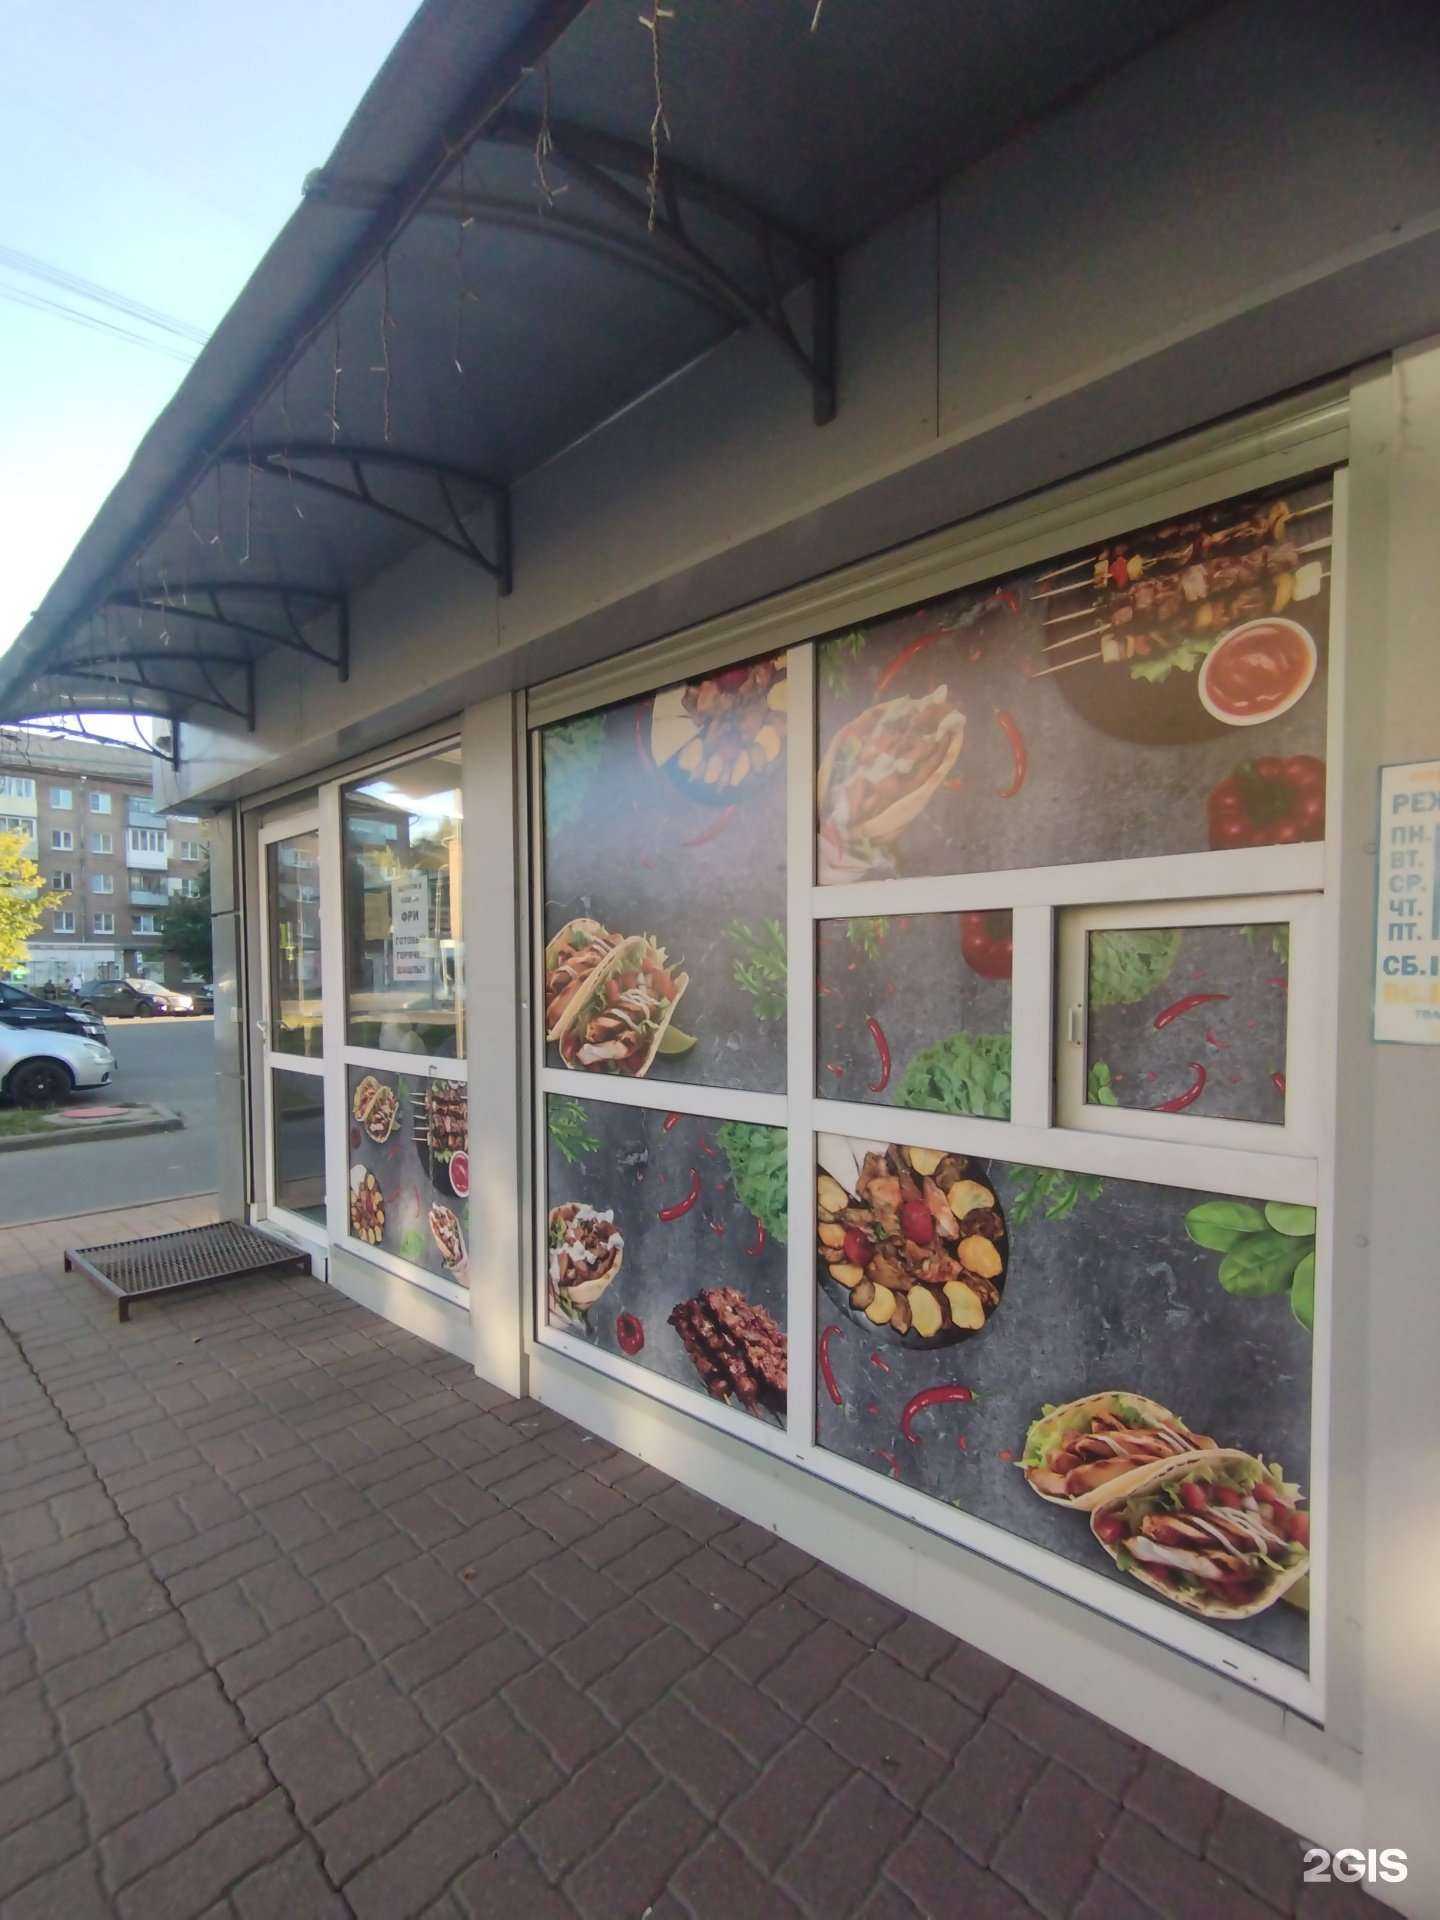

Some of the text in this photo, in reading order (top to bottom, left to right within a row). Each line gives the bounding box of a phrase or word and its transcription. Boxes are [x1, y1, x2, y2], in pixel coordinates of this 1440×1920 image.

[1389, 874, 1427, 893] СР.
[1389, 898, 1423, 917] ЧТ.
[1388, 922, 1422, 941] ПТ.
[1383, 955, 1426, 976] СБ.
